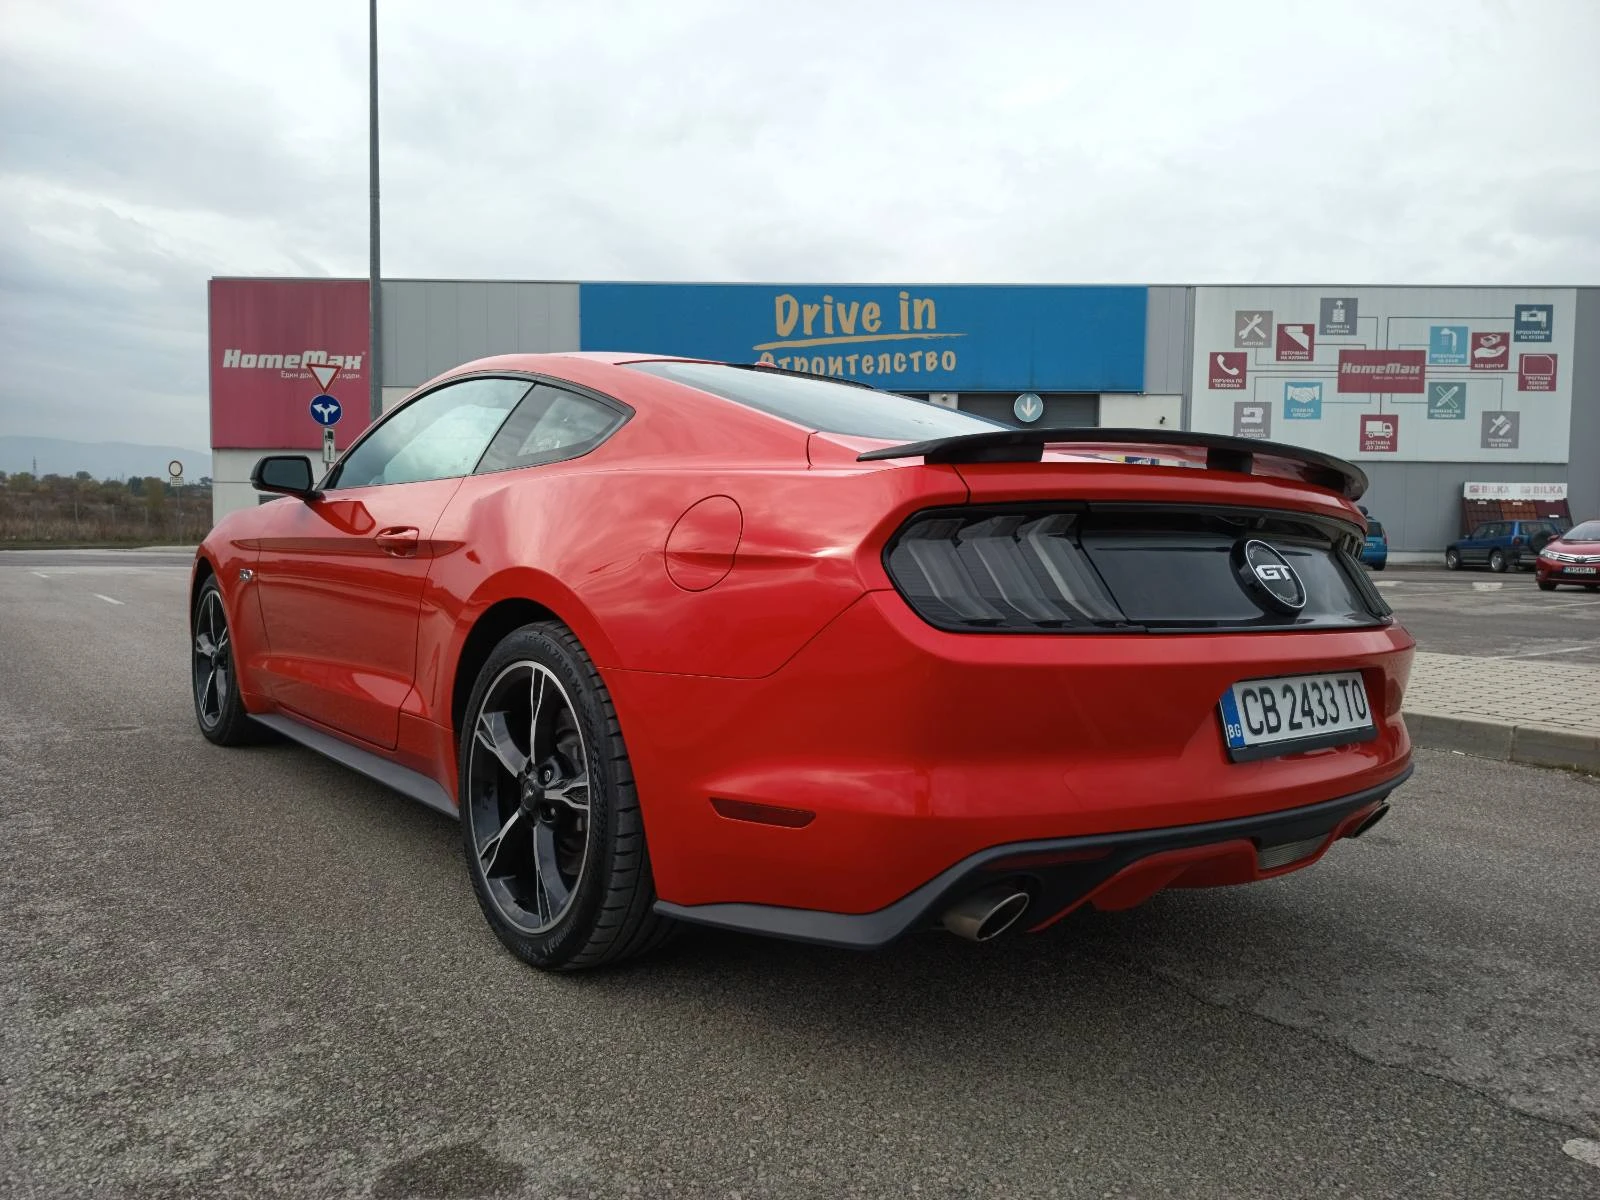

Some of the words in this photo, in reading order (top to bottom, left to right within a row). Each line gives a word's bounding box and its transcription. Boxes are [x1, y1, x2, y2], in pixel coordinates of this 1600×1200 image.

[775, 293, 882, 337] Drive
[899, 291, 936, 331] in
[223, 349, 362, 370] HomeMax
[1341, 362, 1421, 374] HomeMax
[1482, 485, 1510, 494] BILKA
[1534, 485, 1563, 494] BILKA
[1255, 564, 1292, 581] GT
[1241, 686, 1281, 736] CB
[1282, 681, 1340, 731] 2433
[1338, 678, 1367, 722] TO
[1227, 723, 1242, 738] BG
